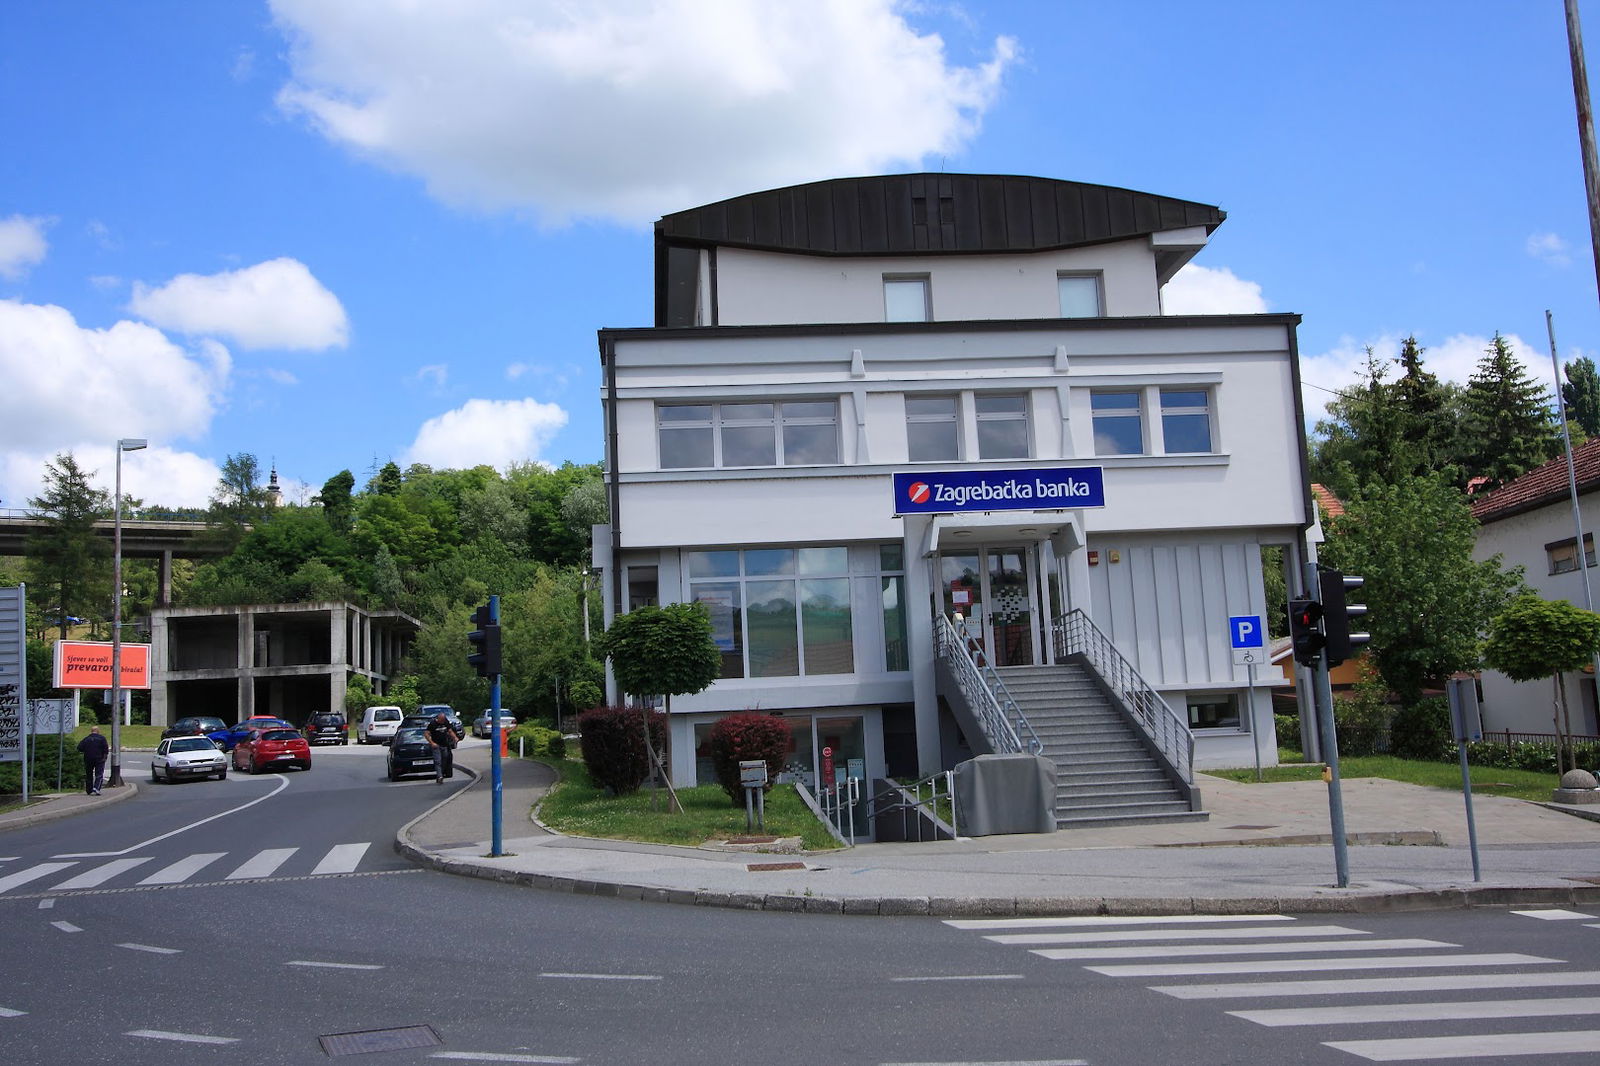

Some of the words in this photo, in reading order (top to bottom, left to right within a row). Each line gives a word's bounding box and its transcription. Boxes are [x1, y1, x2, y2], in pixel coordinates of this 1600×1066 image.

[934, 479, 1033, 506] Zagrebačka
[1035, 477, 1089, 498] banka
[1238, 621, 1253, 643] P
[67, 655, 86, 664] Sjever
